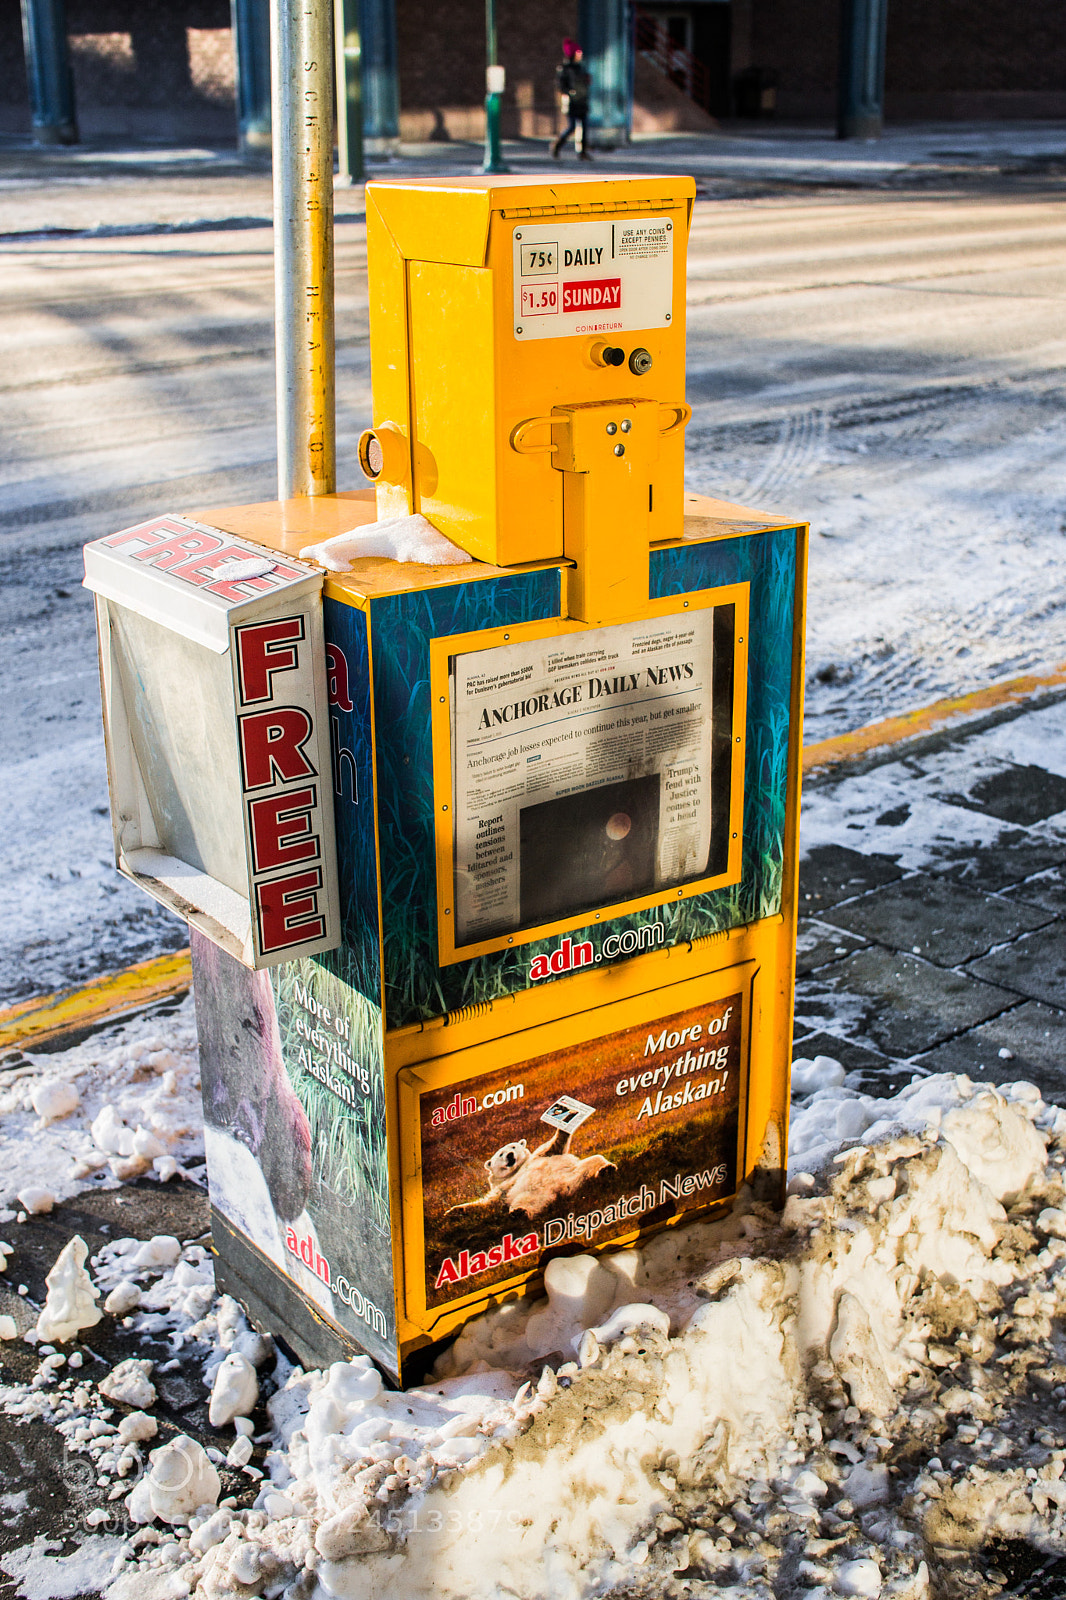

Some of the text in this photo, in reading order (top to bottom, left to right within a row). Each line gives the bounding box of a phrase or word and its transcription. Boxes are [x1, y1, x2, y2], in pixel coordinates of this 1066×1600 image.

[530, 248, 604, 268] 75¢ DAILY
[522, 285, 621, 309] $1.50 SUNDAY
[575, 325, 594, 333] COIN
[100, 517, 308, 604] FREE
[632, 640, 651, 648] Frenzied
[677, 638, 693, 646] passage
[552, 657, 563, 665] killed
[586, 649, 605, 657] carrying
[580, 657, 597, 665] collides
[486, 675, 499, 684] raised
[478, 685, 583, 731] ANCHORAGE
[588, 673, 641, 699] DAILY
[645, 662, 694, 688] NEWS
[467, 703, 702, 768] Anchorage job losses expected to continue this year, but get smaller
[667, 764, 699, 778] Trump's
[234, 614, 327, 956] FREE
[555, 787, 571, 796] SUPER
[572, 784, 585, 792] MOON
[606, 774, 624, 783] ALASKA
[665, 774, 701, 790] feud with
[670, 788, 697, 801] Justice
[666, 801, 691, 813] comes
[677, 809, 697, 821] head
[478, 814, 504, 829] Report
[475, 835, 506, 850] tensions
[476, 825, 505, 840] outlines
[467, 851, 513, 872] Iditarod and
[475, 845, 505, 860] between
[473, 866, 508, 881] sponsors,
[475, 876, 506, 891] mushers
[529, 921, 665, 981] adn.com
[294, 980, 350, 1041] More of
[644, 1007, 733, 1057] More of
[295, 1018, 370, 1095] everything
[298, 1045, 356, 1108] Alaskan!
[616, 1045, 730, 1097] everything
[431, 1082, 525, 1127] adn.com
[636, 1071, 729, 1121] Alaskan!
[434, 1163, 729, 1289] Alaska Dispatch News
[285, 1226, 388, 1340] adn.com
